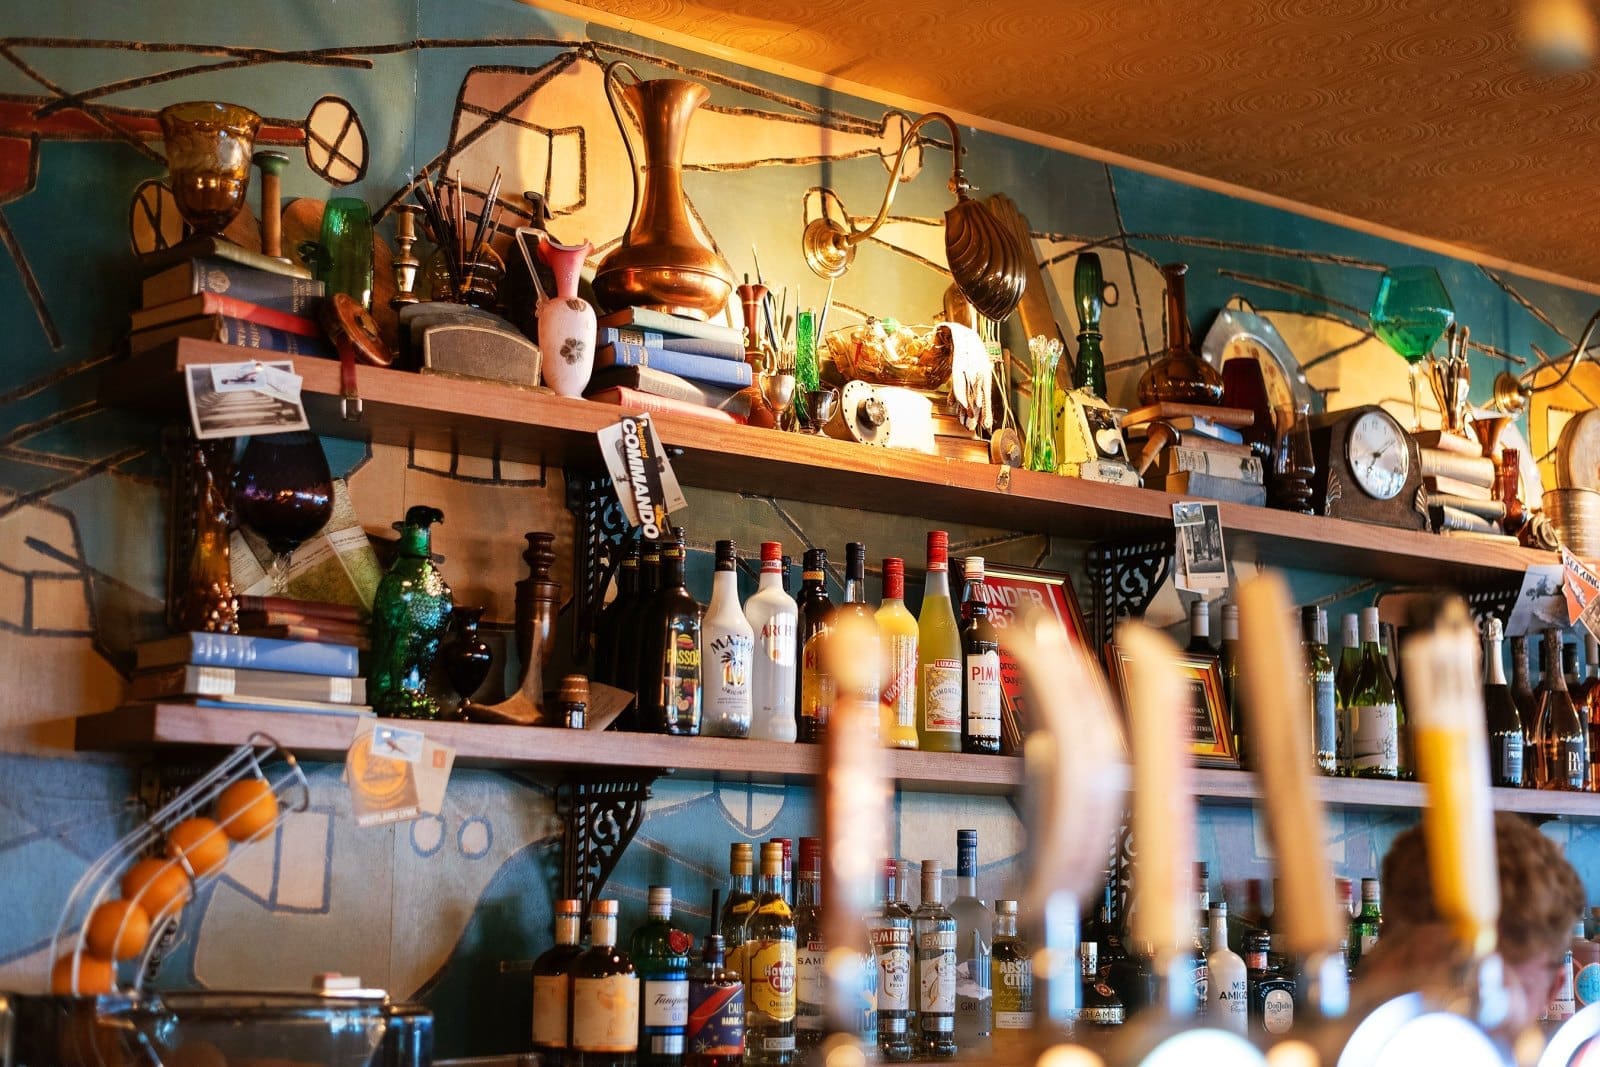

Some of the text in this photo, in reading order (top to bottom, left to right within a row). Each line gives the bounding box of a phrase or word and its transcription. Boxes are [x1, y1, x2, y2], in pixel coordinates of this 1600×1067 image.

[622, 418, 660, 540] COMMANDO
[772, 977, 793, 989] Club
[1550, 1002, 1564, 1011] GIN
